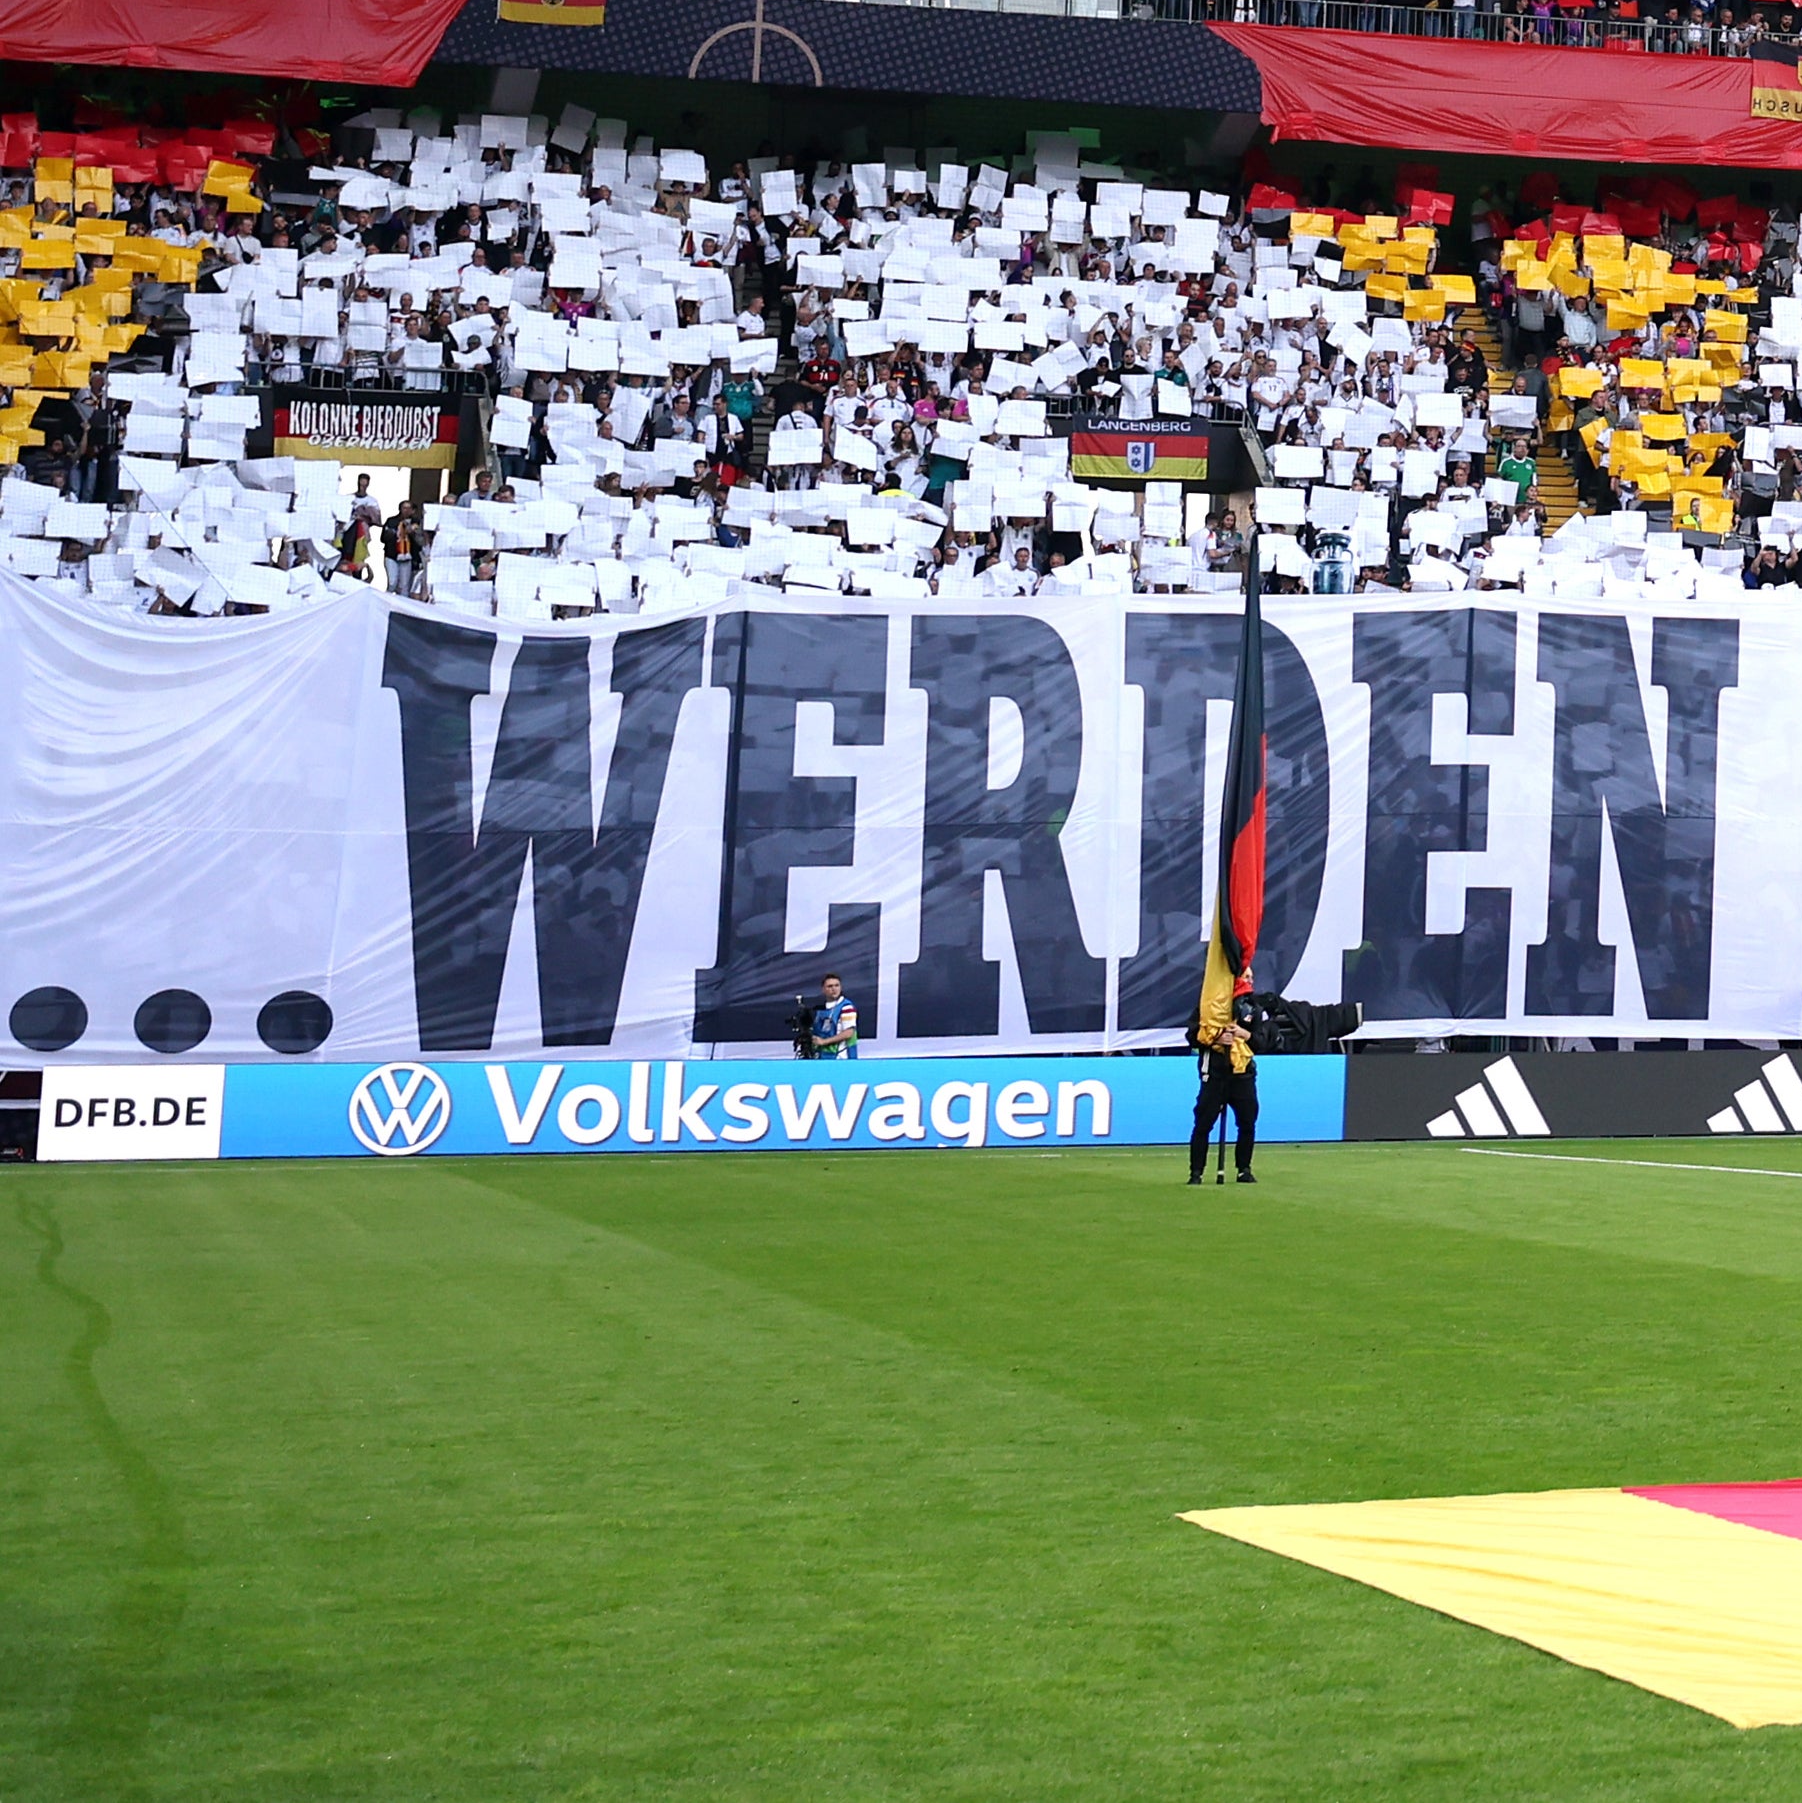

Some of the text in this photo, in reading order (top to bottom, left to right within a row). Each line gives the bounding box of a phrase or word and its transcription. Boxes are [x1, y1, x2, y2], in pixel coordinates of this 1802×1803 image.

[289, 400, 441, 440] KOLONNE BIERDURST
[1087, 418, 1192, 432] LANGENBERG
[308, 432, 433, 451] OBERHAUSEN
[381, 610, 1740, 1052] WERDEN
[53, 1096, 208, 1127] DFB.DE
[485, 1062, 1112, 1149] Volkswagen
